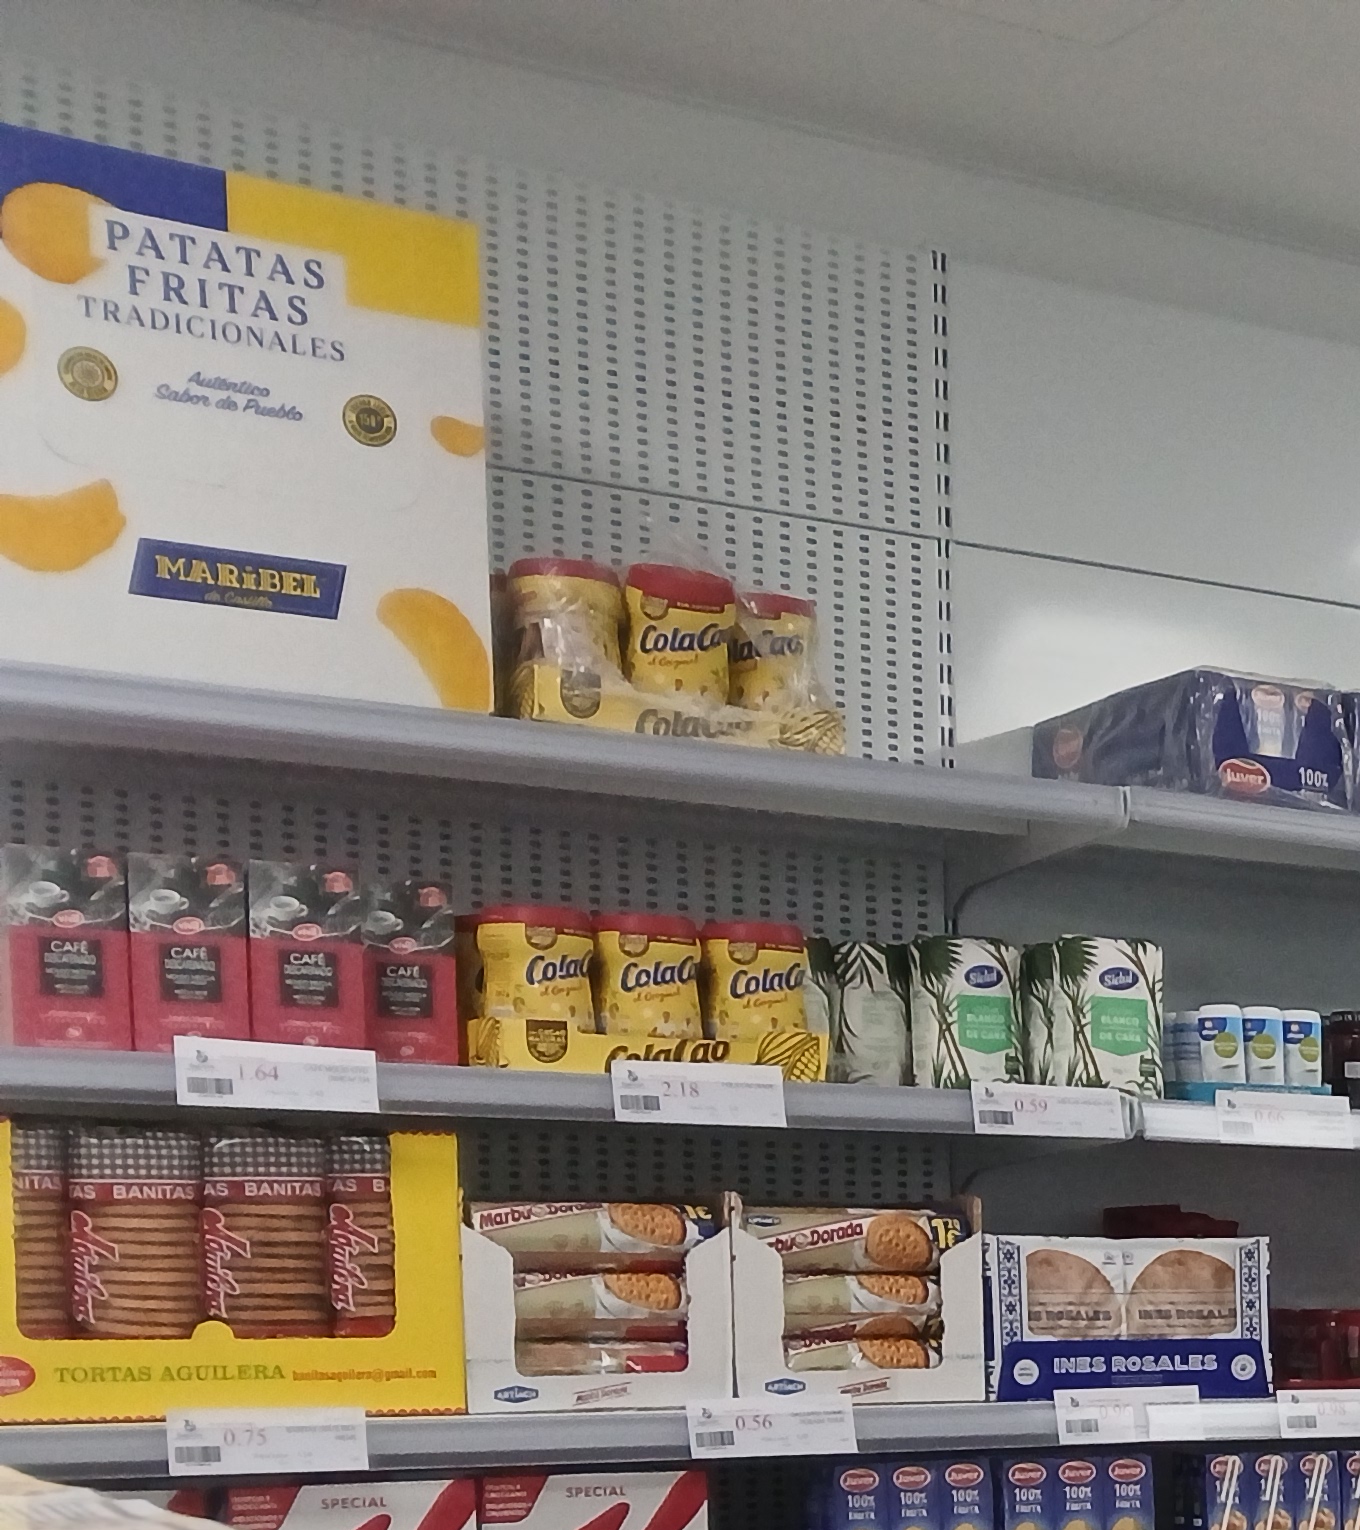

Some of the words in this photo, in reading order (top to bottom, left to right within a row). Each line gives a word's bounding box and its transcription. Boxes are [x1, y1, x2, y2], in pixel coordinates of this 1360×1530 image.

[105, 219, 325, 290] PATATAS
[127, 264, 308, 326] FRITAS
[77, 294, 345, 362] TRADICIONALES
[155, 383, 213, 408] Sabor
[243, 398, 303, 422] Pueblo
[1299, 767, 1328, 787] 100%
[51, 941, 88, 954] CAFÉ
[171, 947, 208, 959] CAFÉ
[290, 953, 326, 965] CAFÉ
[387, 966, 419, 977] CAFÉ
[236, 1062, 280, 1082] 1.64
[663, 1081, 700, 1098] 2.18
[1015, 1099, 1048, 1113] 0.59
[113, 1185, 194, 1200] BANITAS
[244, 1182, 321, 1197] BANITAS
[809, 1222, 863, 1248] Dorada
[1053, 1357, 1107, 1373] INES
[1111, 1354, 1218, 1372] ROSALES
[54, 1366, 152, 1384] TORTAS
[160, 1364, 285, 1382] AGUILERA
[735, 1413, 773, 1432] 0.56
[223, 1427, 268, 1447] 0.75
[565, 1485, 627, 1498] SPECIAL
[951, 1489, 980, 1503] 100%
[1014, 1488, 1042, 1502] 100%
[1063, 1486, 1092, 1500] 100%
[1114, 1483, 1142, 1498] 100%
[321, 1496, 387, 1510] SPECIAL
[846, 1494, 876, 1508] 100%
[899, 1492, 928, 1506] 100%
